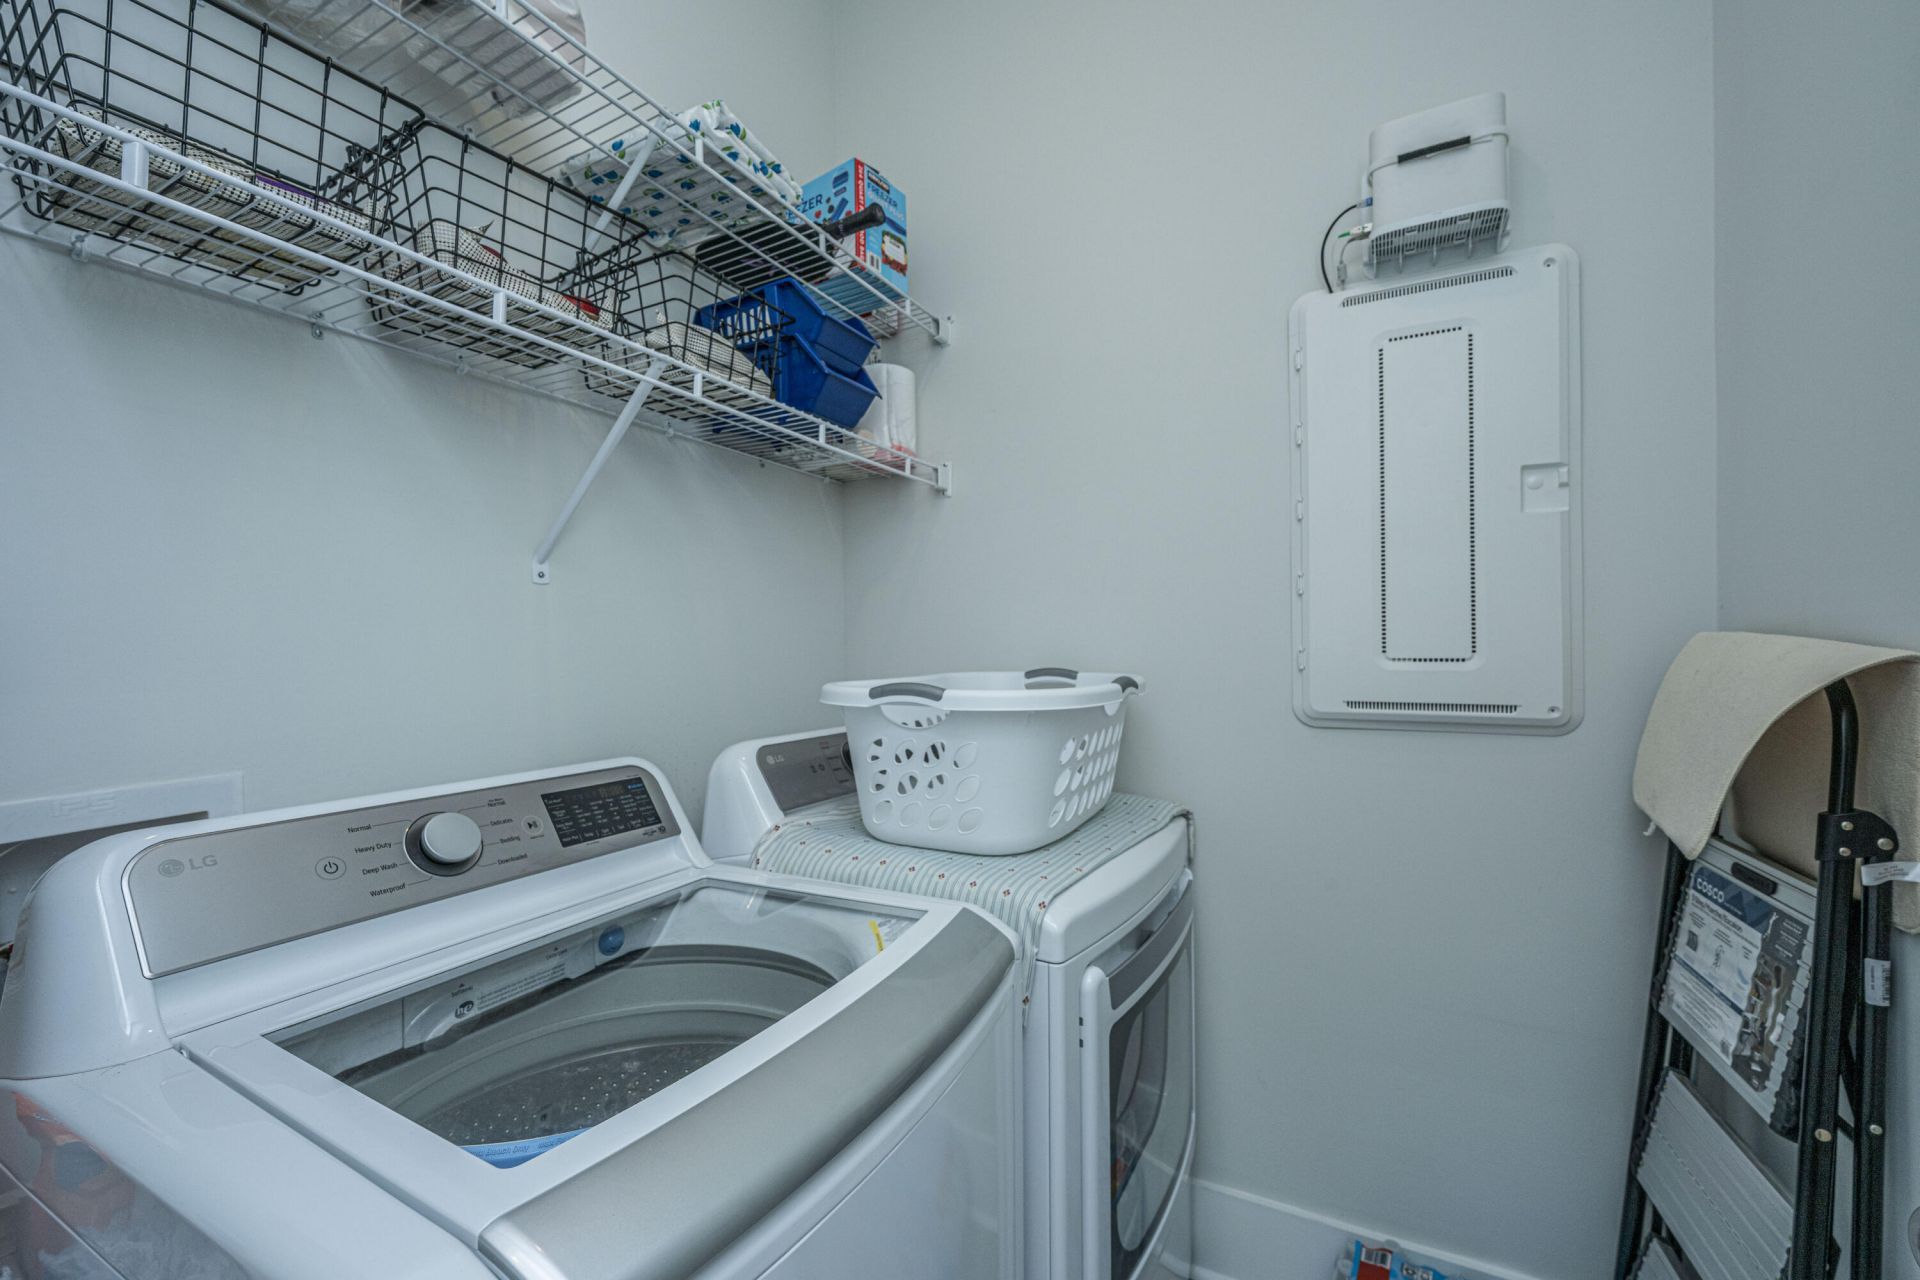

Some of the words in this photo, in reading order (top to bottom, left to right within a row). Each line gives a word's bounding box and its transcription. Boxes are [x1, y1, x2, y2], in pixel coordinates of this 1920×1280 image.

[867, 180, 898, 208] FREEZER
[347, 824, 372, 833] Normal
[354, 845, 375, 854] Heavy
[188, 855, 218, 870] LG
[362, 867, 380, 875] Deep
[380, 863, 398, 871] Wash
[369, 883, 406, 897] Waterproof
[1696, 878, 1724, 903] COSCO
